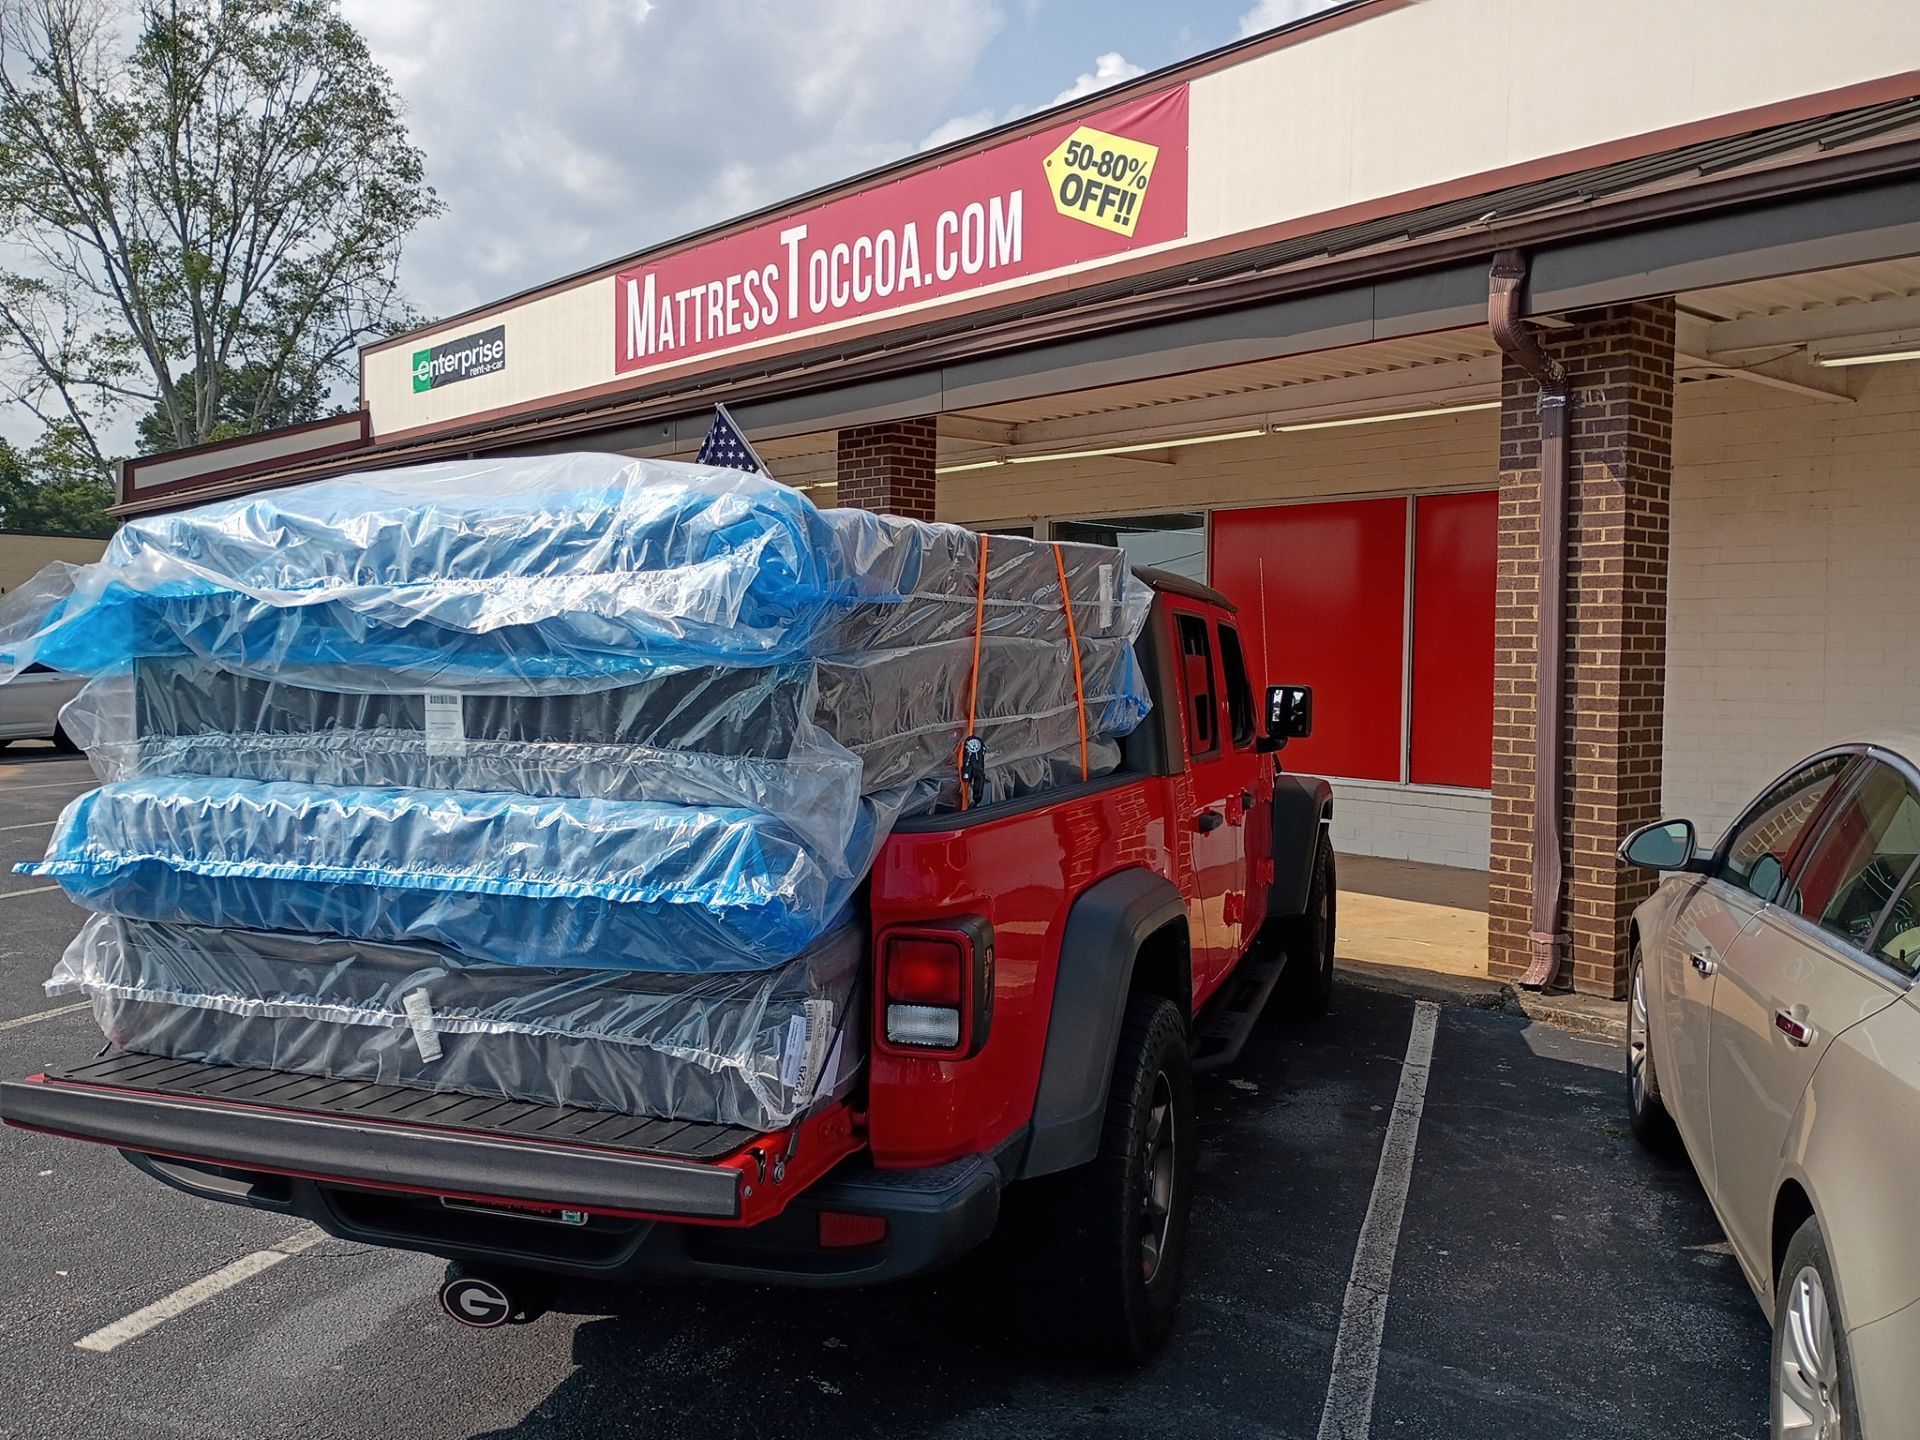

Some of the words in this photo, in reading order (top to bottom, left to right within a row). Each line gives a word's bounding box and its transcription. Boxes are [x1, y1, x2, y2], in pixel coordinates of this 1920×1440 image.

[1064, 140, 1148, 190] 50-80%
[1060, 173, 1138, 226] OFF!!
[413, 339, 504, 381] enterprise
[469, 360, 504, 376] rent-a-car
[794, 1066, 808, 1097] 2229
[460, 1288, 508, 1316] G
